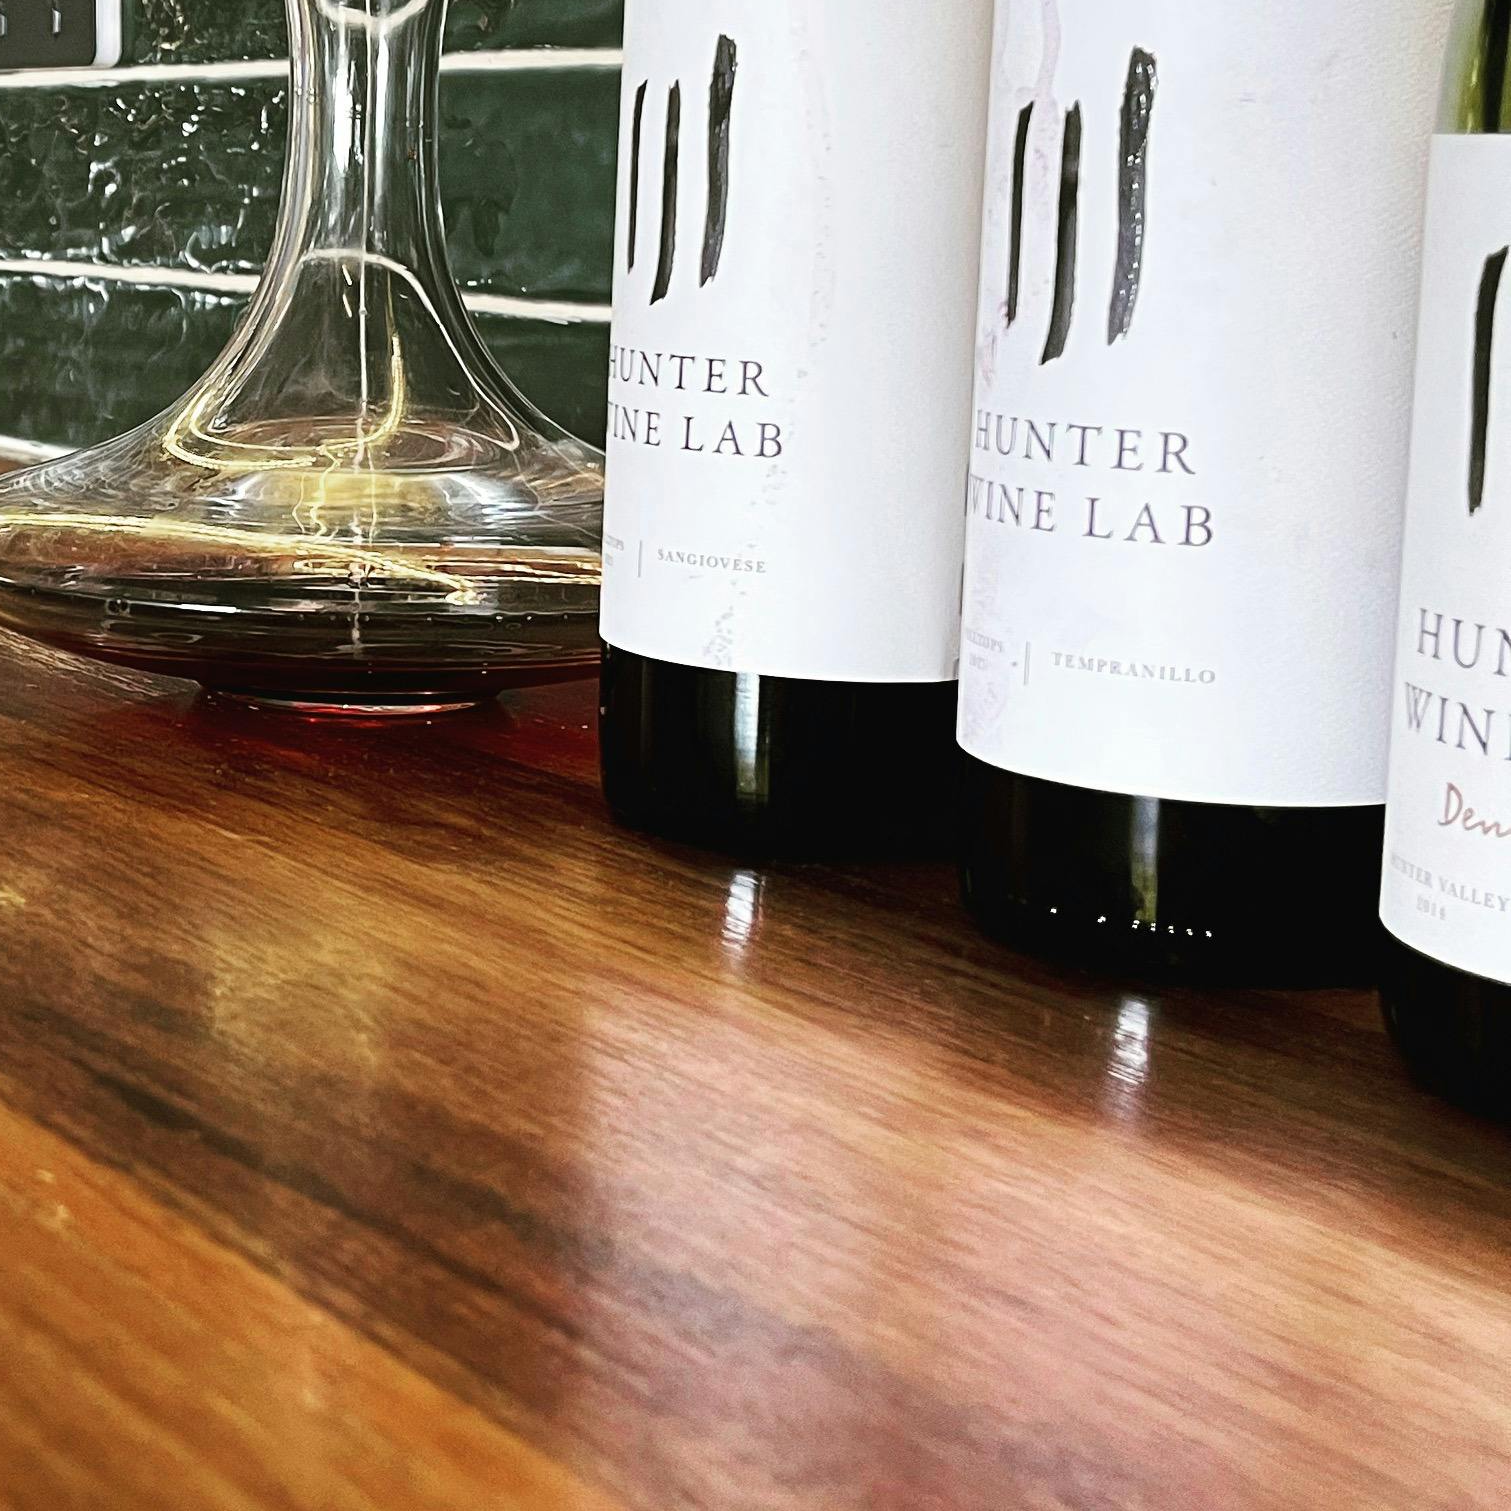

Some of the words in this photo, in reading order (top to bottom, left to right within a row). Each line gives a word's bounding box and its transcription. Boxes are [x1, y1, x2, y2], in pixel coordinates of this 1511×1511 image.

[608, 401, 661, 447] INE
[680, 416, 783, 458] LAB
[974, 409, 1197, 475] HUNTER
[1082, 497, 1214, 548] LAB
[656, 548, 767, 574] SANGIOVESE
[1051, 651, 1217, 685] TEMPRANILLO
[1404, 682, 1511, 762] WIN
[1437, 875, 1511, 912] VALLEY
